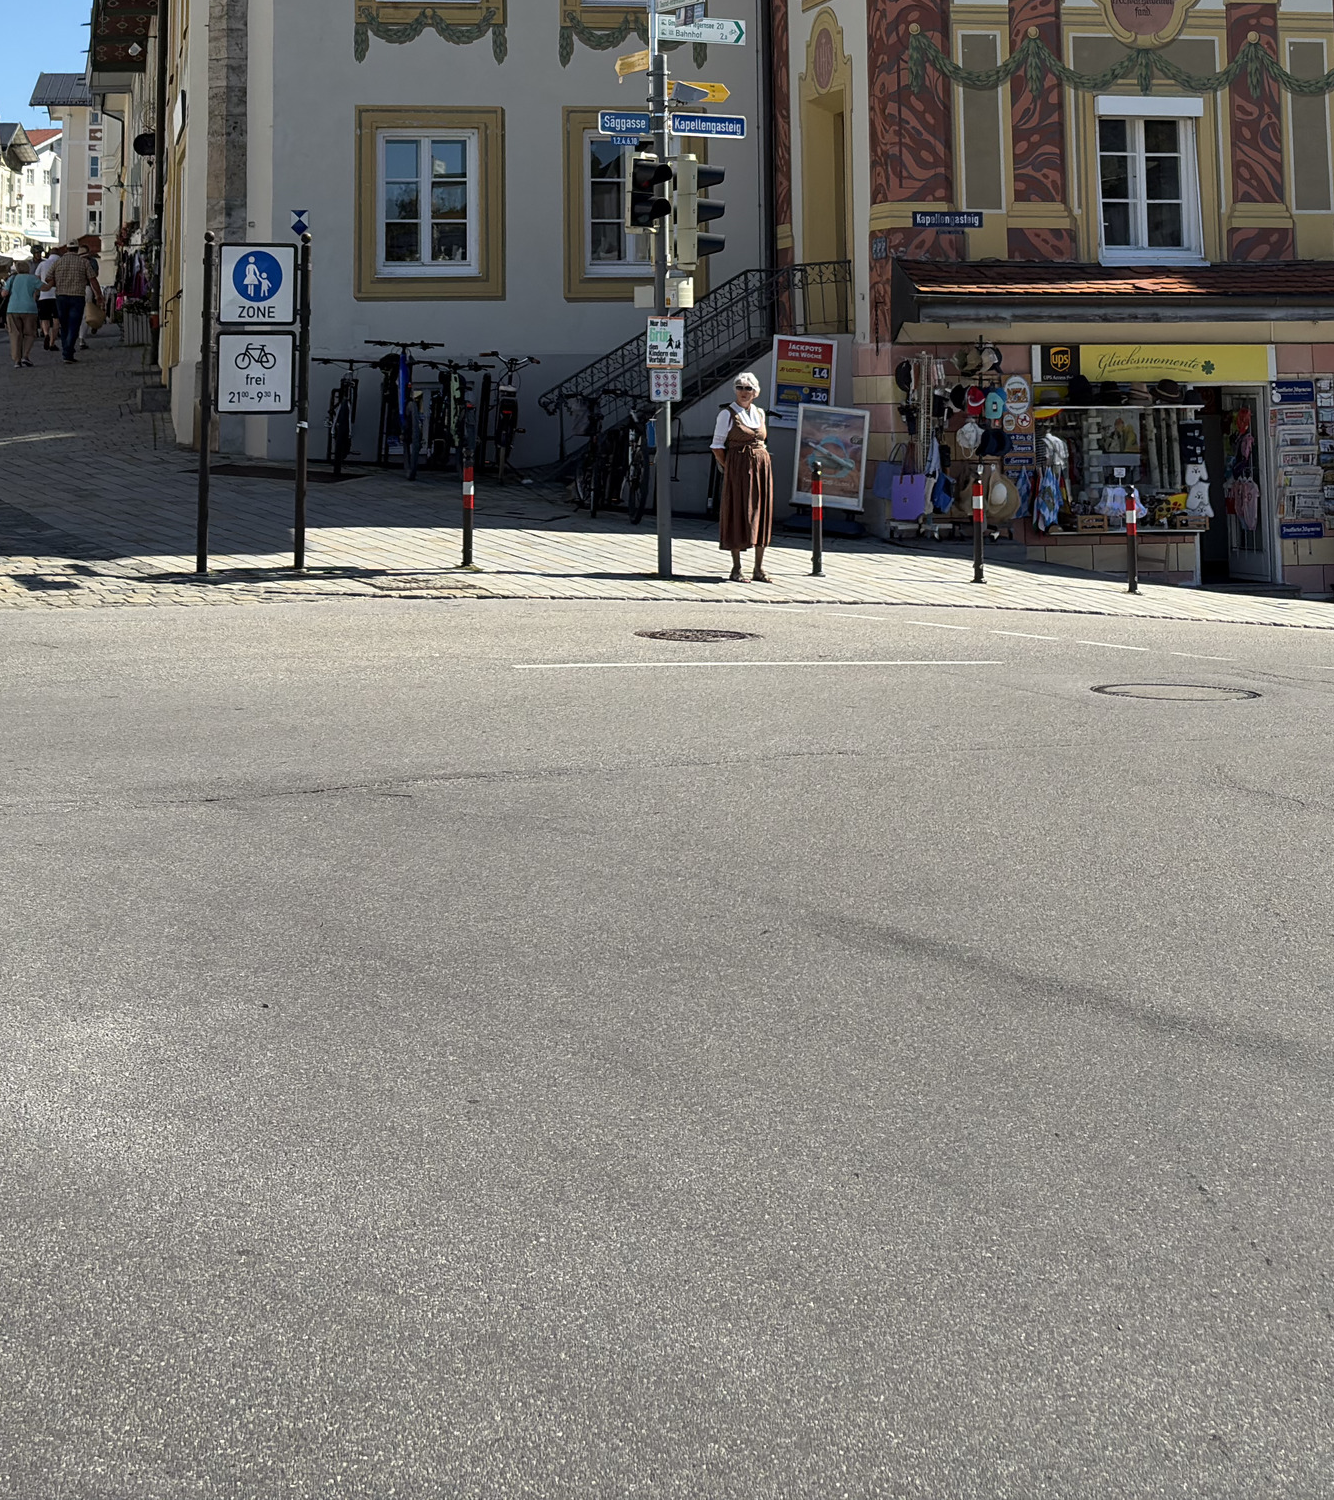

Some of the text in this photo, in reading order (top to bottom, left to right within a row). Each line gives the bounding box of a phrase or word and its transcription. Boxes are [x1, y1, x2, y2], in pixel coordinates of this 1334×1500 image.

[675, 30, 702, 39] Bahnhof
[604, 115, 646, 130] Säggasse
[674, 117, 742, 135] Kapellengasteig
[237, 306, 276, 318] ZONE
[788, 342, 822, 353] JACKPOTS
[1052, 354, 1069, 368] ups
[1095, 345, 1201, 380] Glücksmomente
[813, 368, 828, 378] 14
[245, 374, 266, 385] frei
[811, 392, 828, 402] 120
